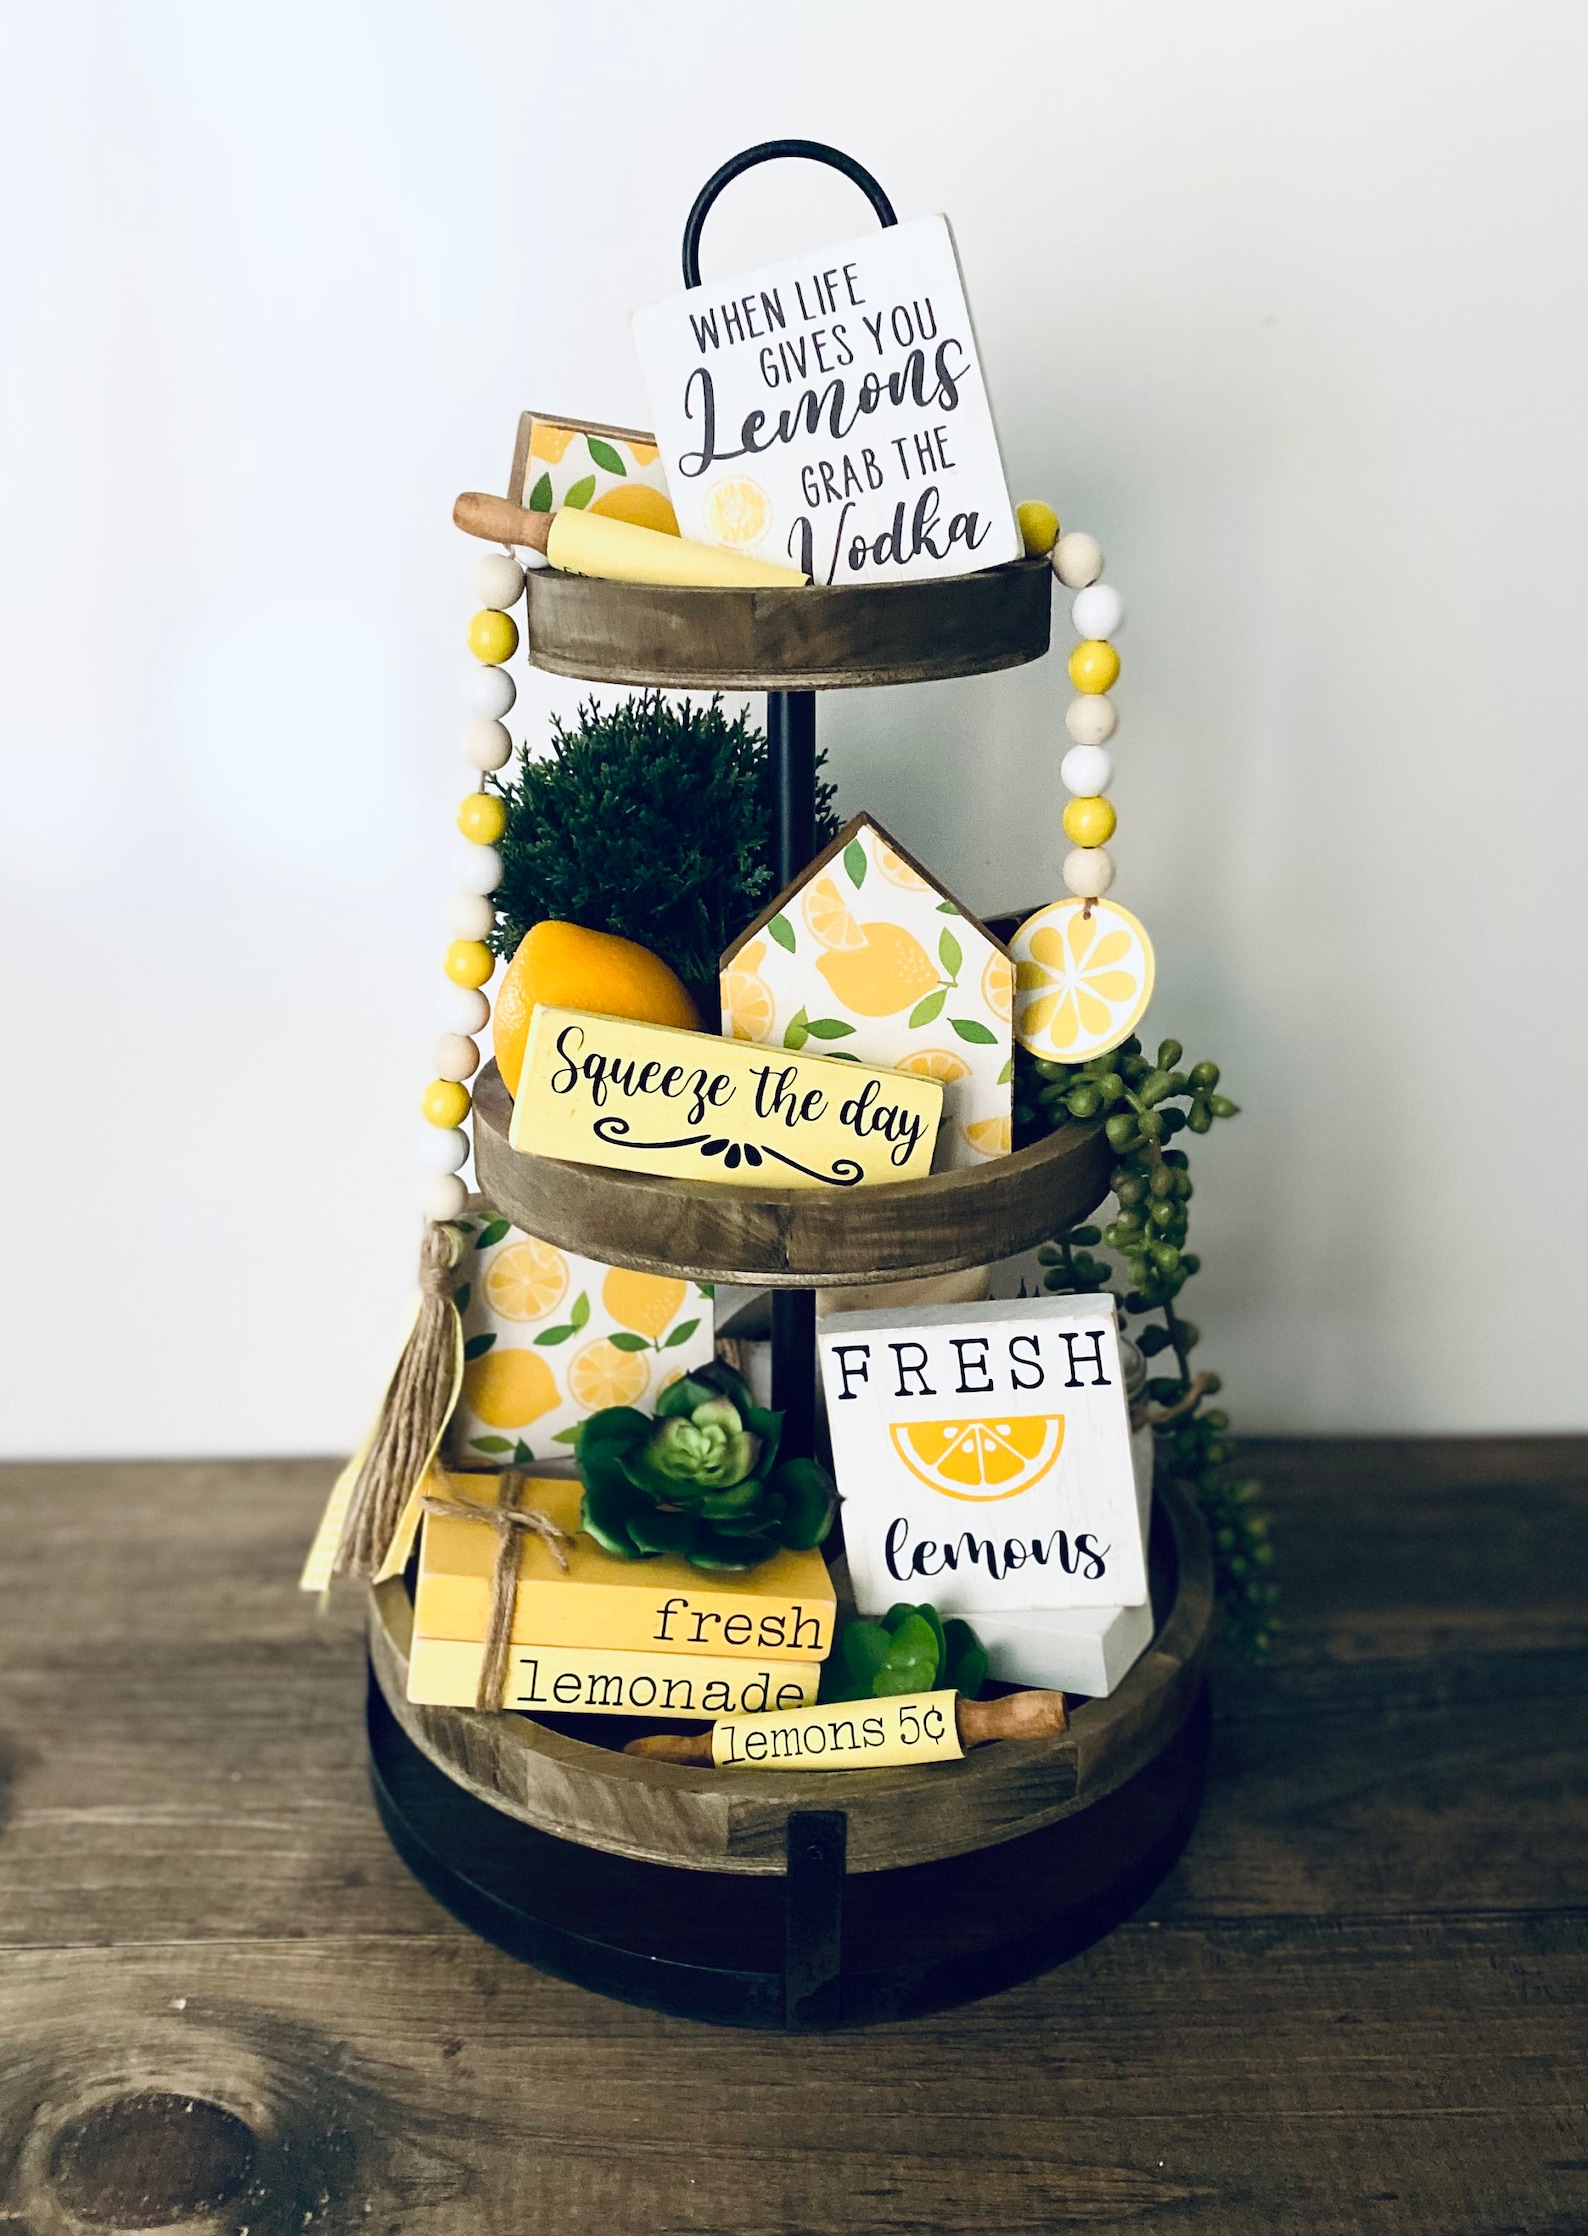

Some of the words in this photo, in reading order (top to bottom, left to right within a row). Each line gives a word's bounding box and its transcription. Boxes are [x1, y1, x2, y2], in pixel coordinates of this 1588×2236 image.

[689, 288, 786, 354] WHEN
[795, 263, 866, 321] LIFE
[760, 324, 854, 388] GIVES
[863, 298, 937, 355] YOU
[679, 338, 971, 478] Lemons
[802, 448, 884, 508] GRAB
[891, 425, 956, 480] THE
[788, 486, 992, 586] Vodka
[551, 1026, 737, 1125] Squeeze
[749, 1066, 829, 1127] the
[839, 1080, 929, 1166] day
[831, 1330, 1112, 1400] FRESH
[885, 1517, 1112, 1581] lemons
[653, 1598, 824, 1650] fresh
[517, 1659, 805, 1714] lemonade
[721, 1716, 885, 1766] lemons
[898, 1705, 946, 1746] 5¢
